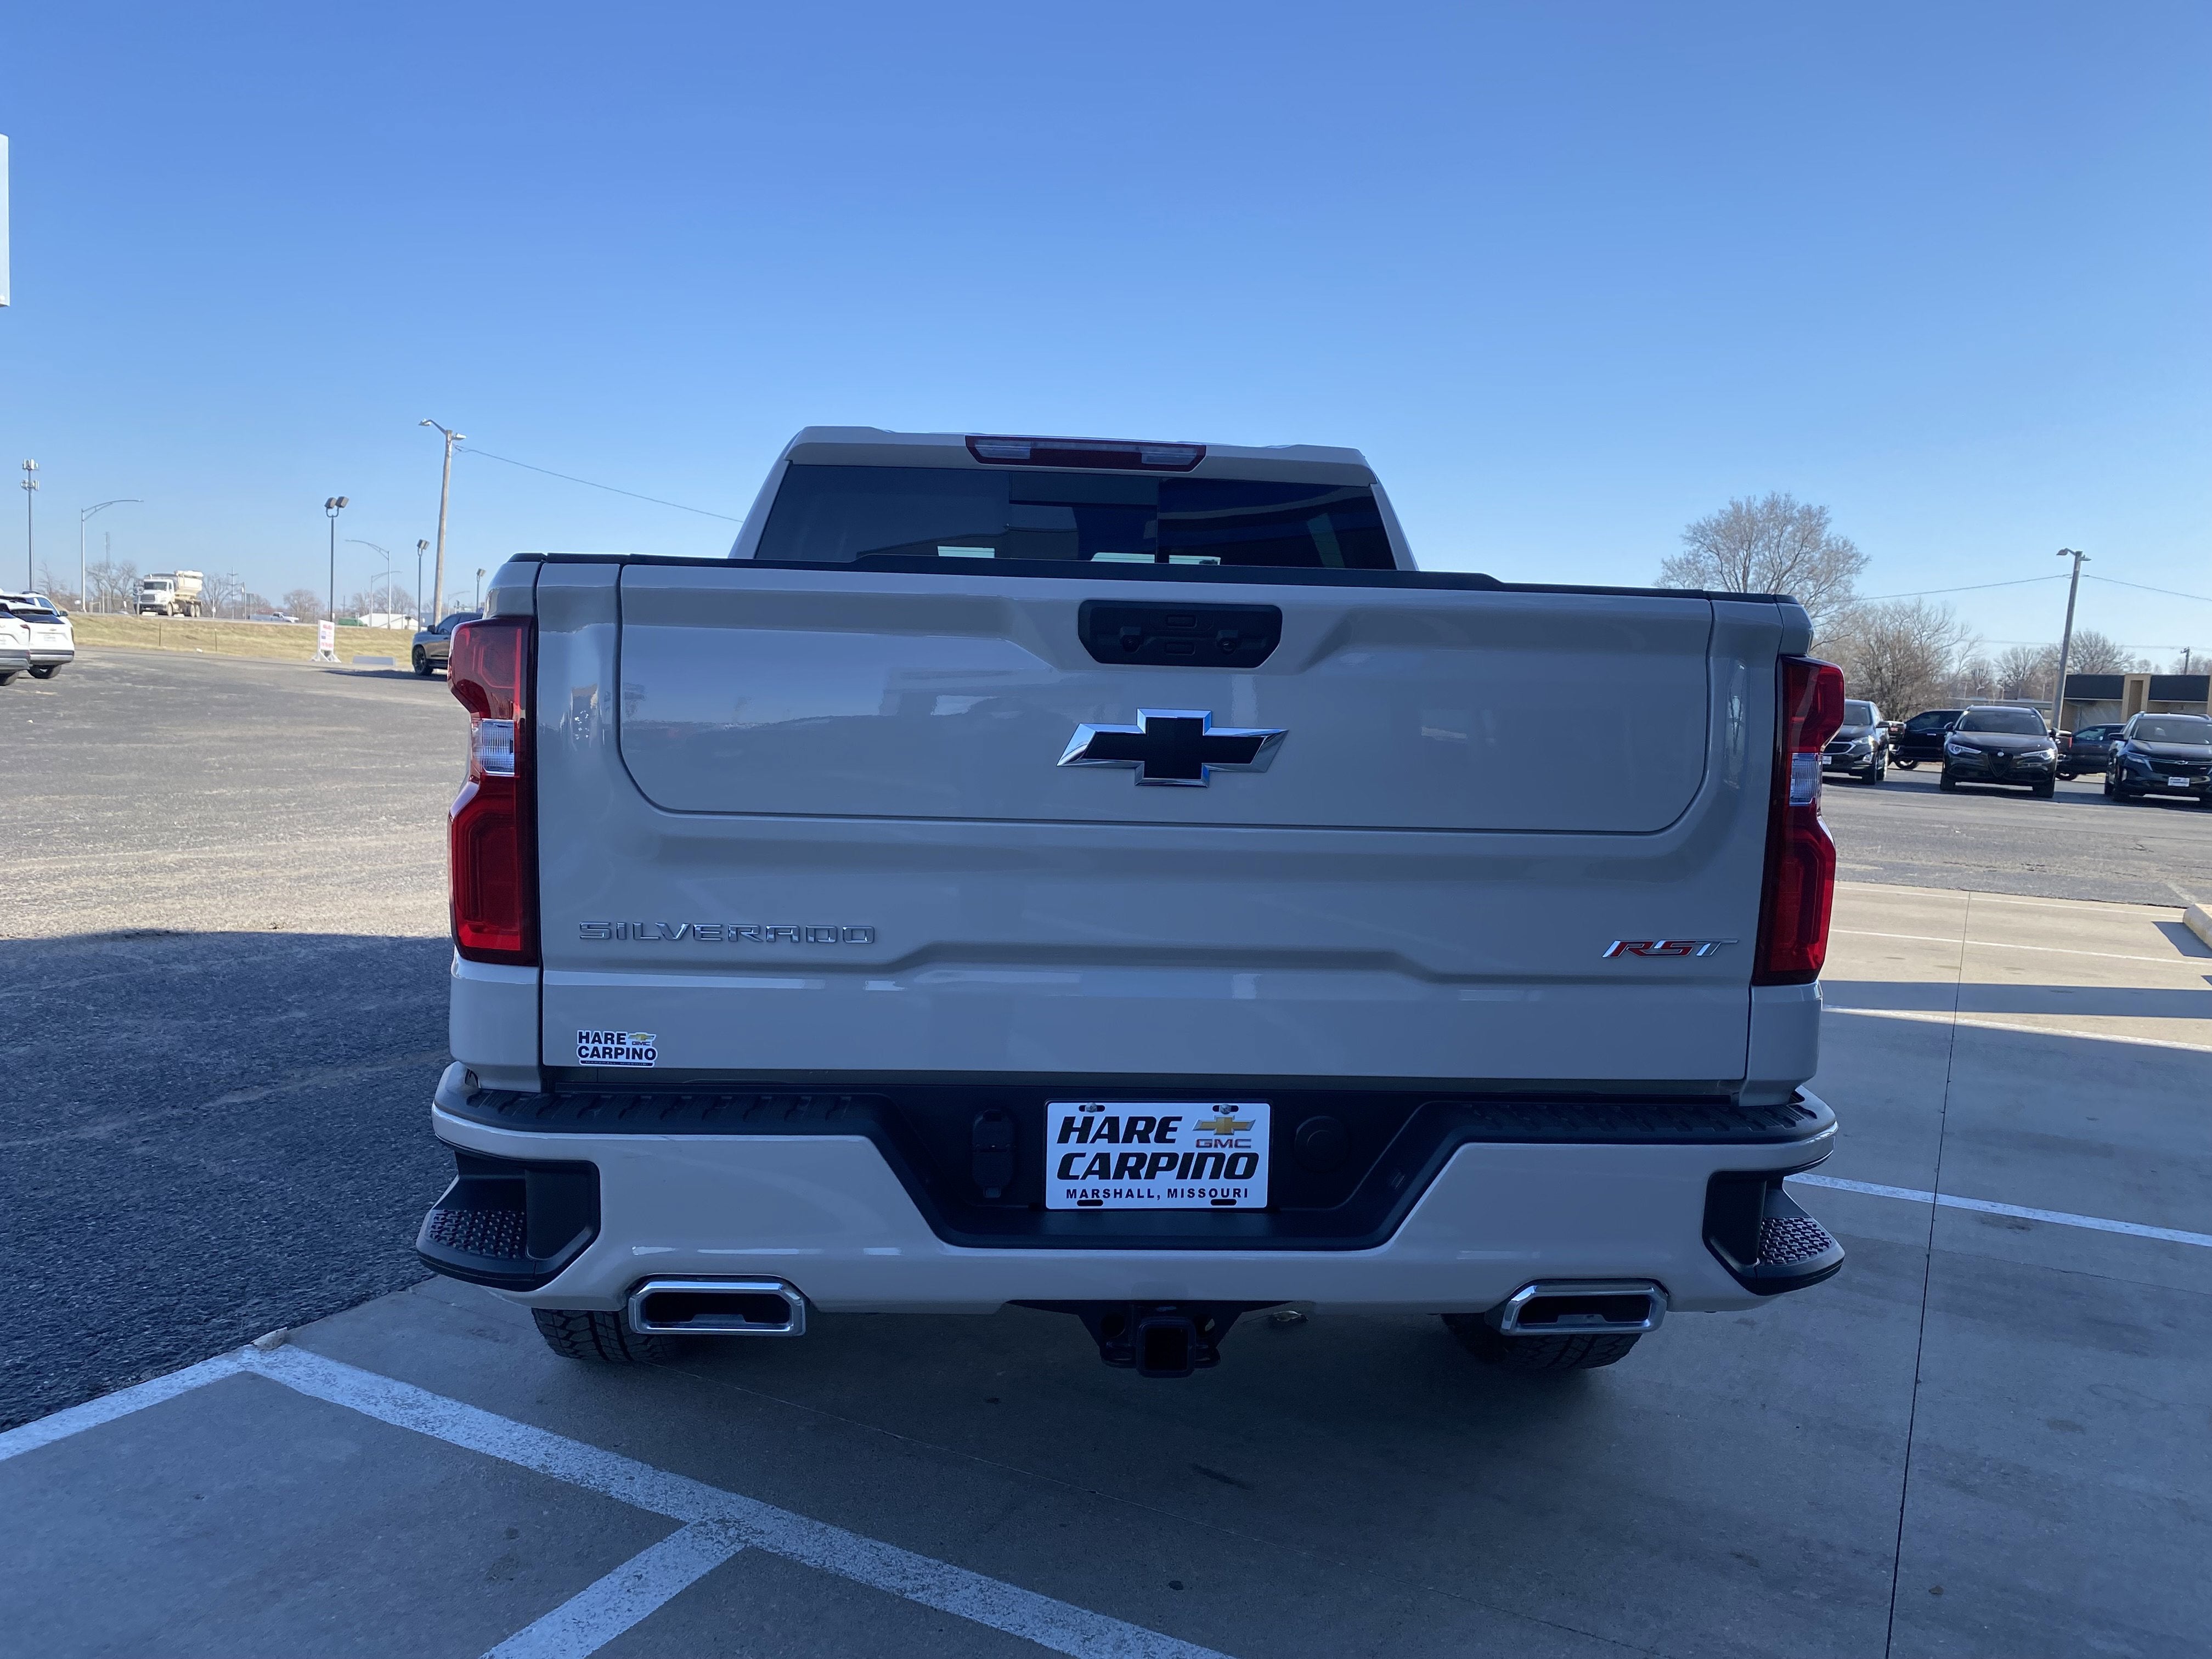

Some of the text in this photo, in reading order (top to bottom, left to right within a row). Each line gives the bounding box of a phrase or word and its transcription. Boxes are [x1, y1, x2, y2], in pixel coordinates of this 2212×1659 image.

[579, 921, 876, 944] SILVERADO
[1602, 939, 1739, 957] RST
[578, 1031, 627, 1045] HARE
[578, 1046, 656, 1060] CARPINO
[1057, 1116, 1183, 1144] HARE
[1195, 1138, 1251, 1149] GMC
[1057, 1152, 1259, 1180] CARPINO
[1066, 1188, 1248, 1200] MARSHALL, MISSOURI
